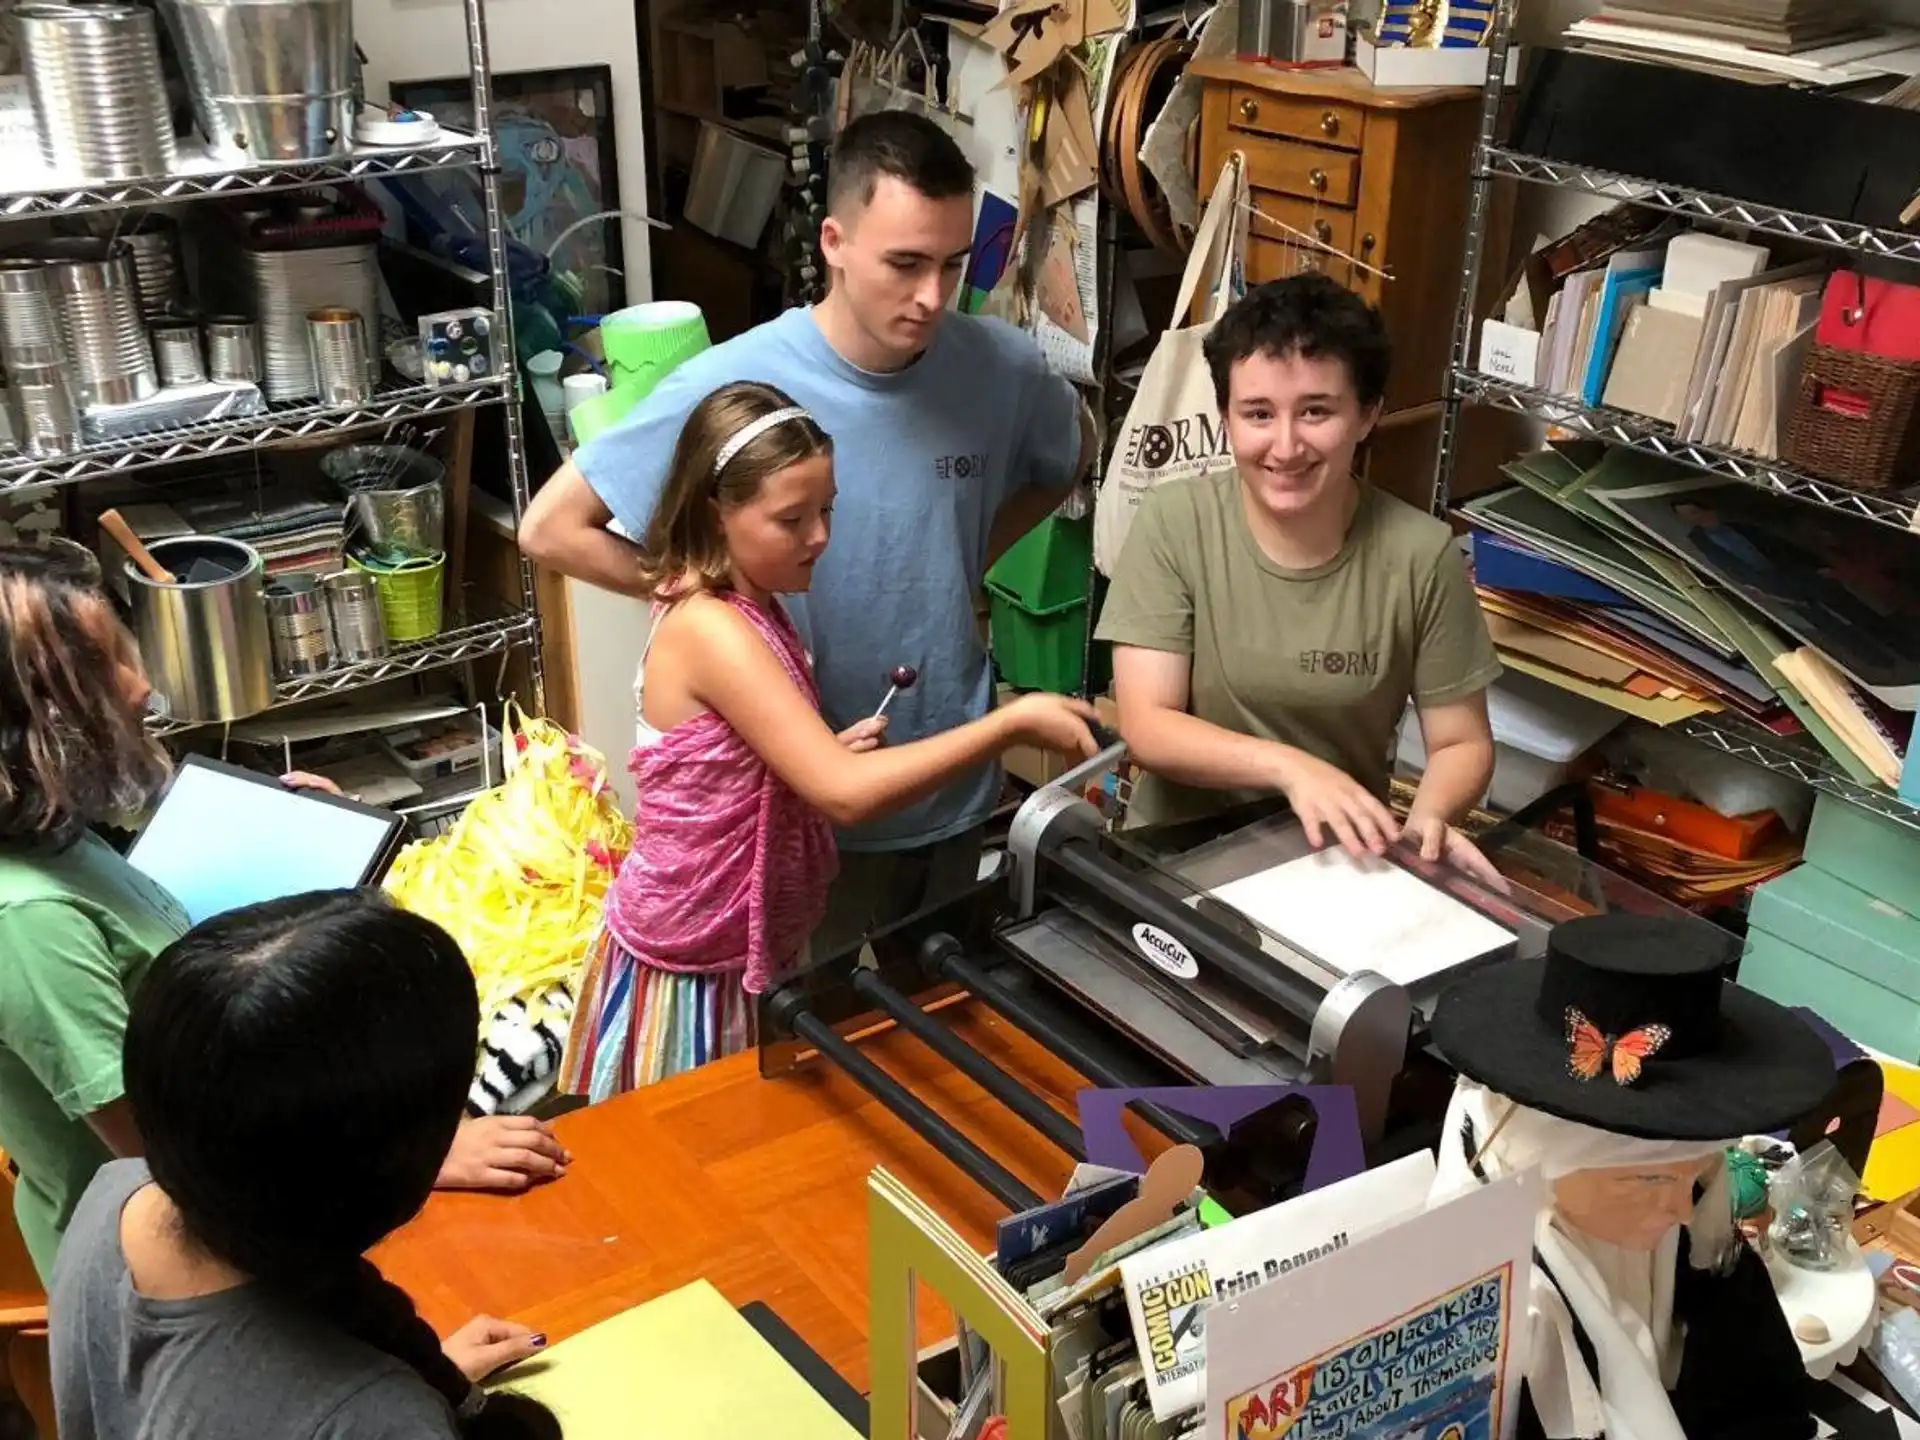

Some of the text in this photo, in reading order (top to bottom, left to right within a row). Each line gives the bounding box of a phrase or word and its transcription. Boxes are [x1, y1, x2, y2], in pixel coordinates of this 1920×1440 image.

[1309, 650, 1380, 676] FORM
[1141, 1268, 1212, 1371] COMIC CON
[1239, 1363, 1316, 1434] ART
